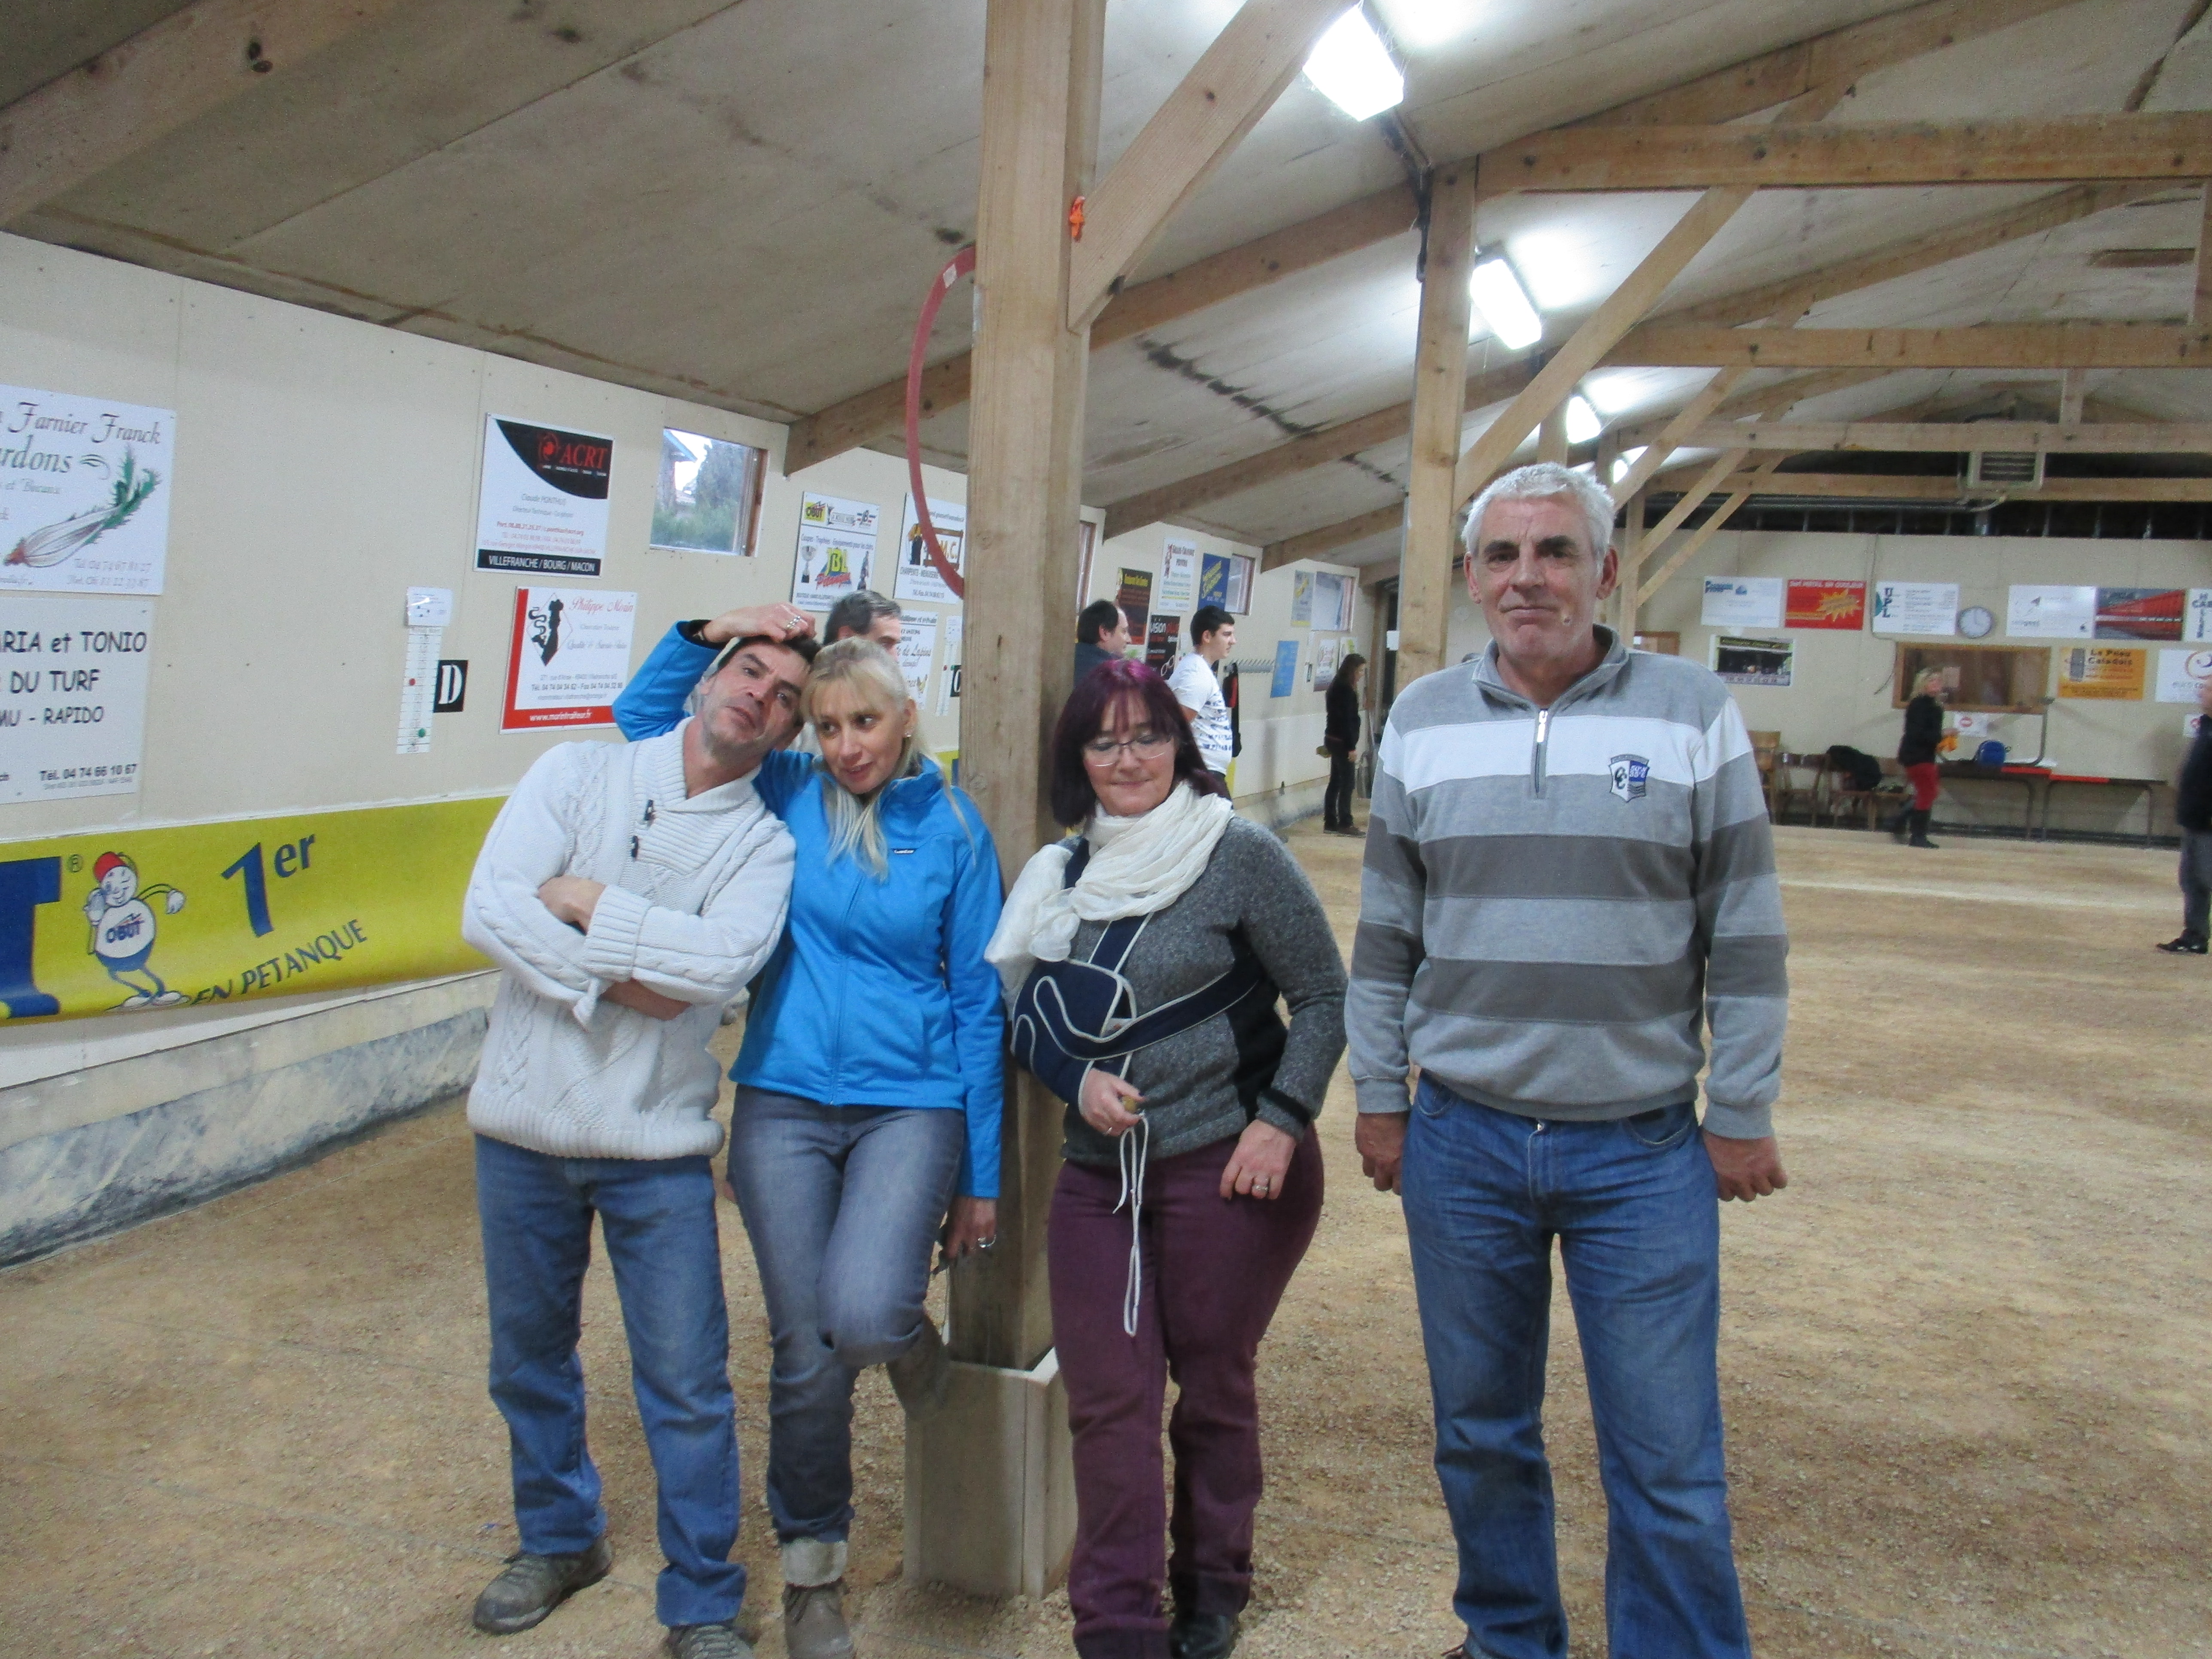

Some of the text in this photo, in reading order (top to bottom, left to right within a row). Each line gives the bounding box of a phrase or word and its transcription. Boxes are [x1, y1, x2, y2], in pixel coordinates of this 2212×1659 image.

[91, 413, 161, 444] Franck
[559, 442, 608, 469] ACRT
[489, 555, 538, 568] VILLEFRANCHE
[543, 559, 567, 571] BOURG
[824, 548, 848, 576] JBL
[569, 596, 604, 615] Philippe
[51, 632, 72, 653] et
[80, 631, 147, 653] TONIO
[10, 668, 101, 694] DU TURF
[438, 665, 463, 705] D
[44, 706, 104, 725] RAPIDO
[221, 833, 317, 939] 1er
[106, 919, 145, 944] OBUT
[191, 919, 368, 1006] EN PETANQUE
